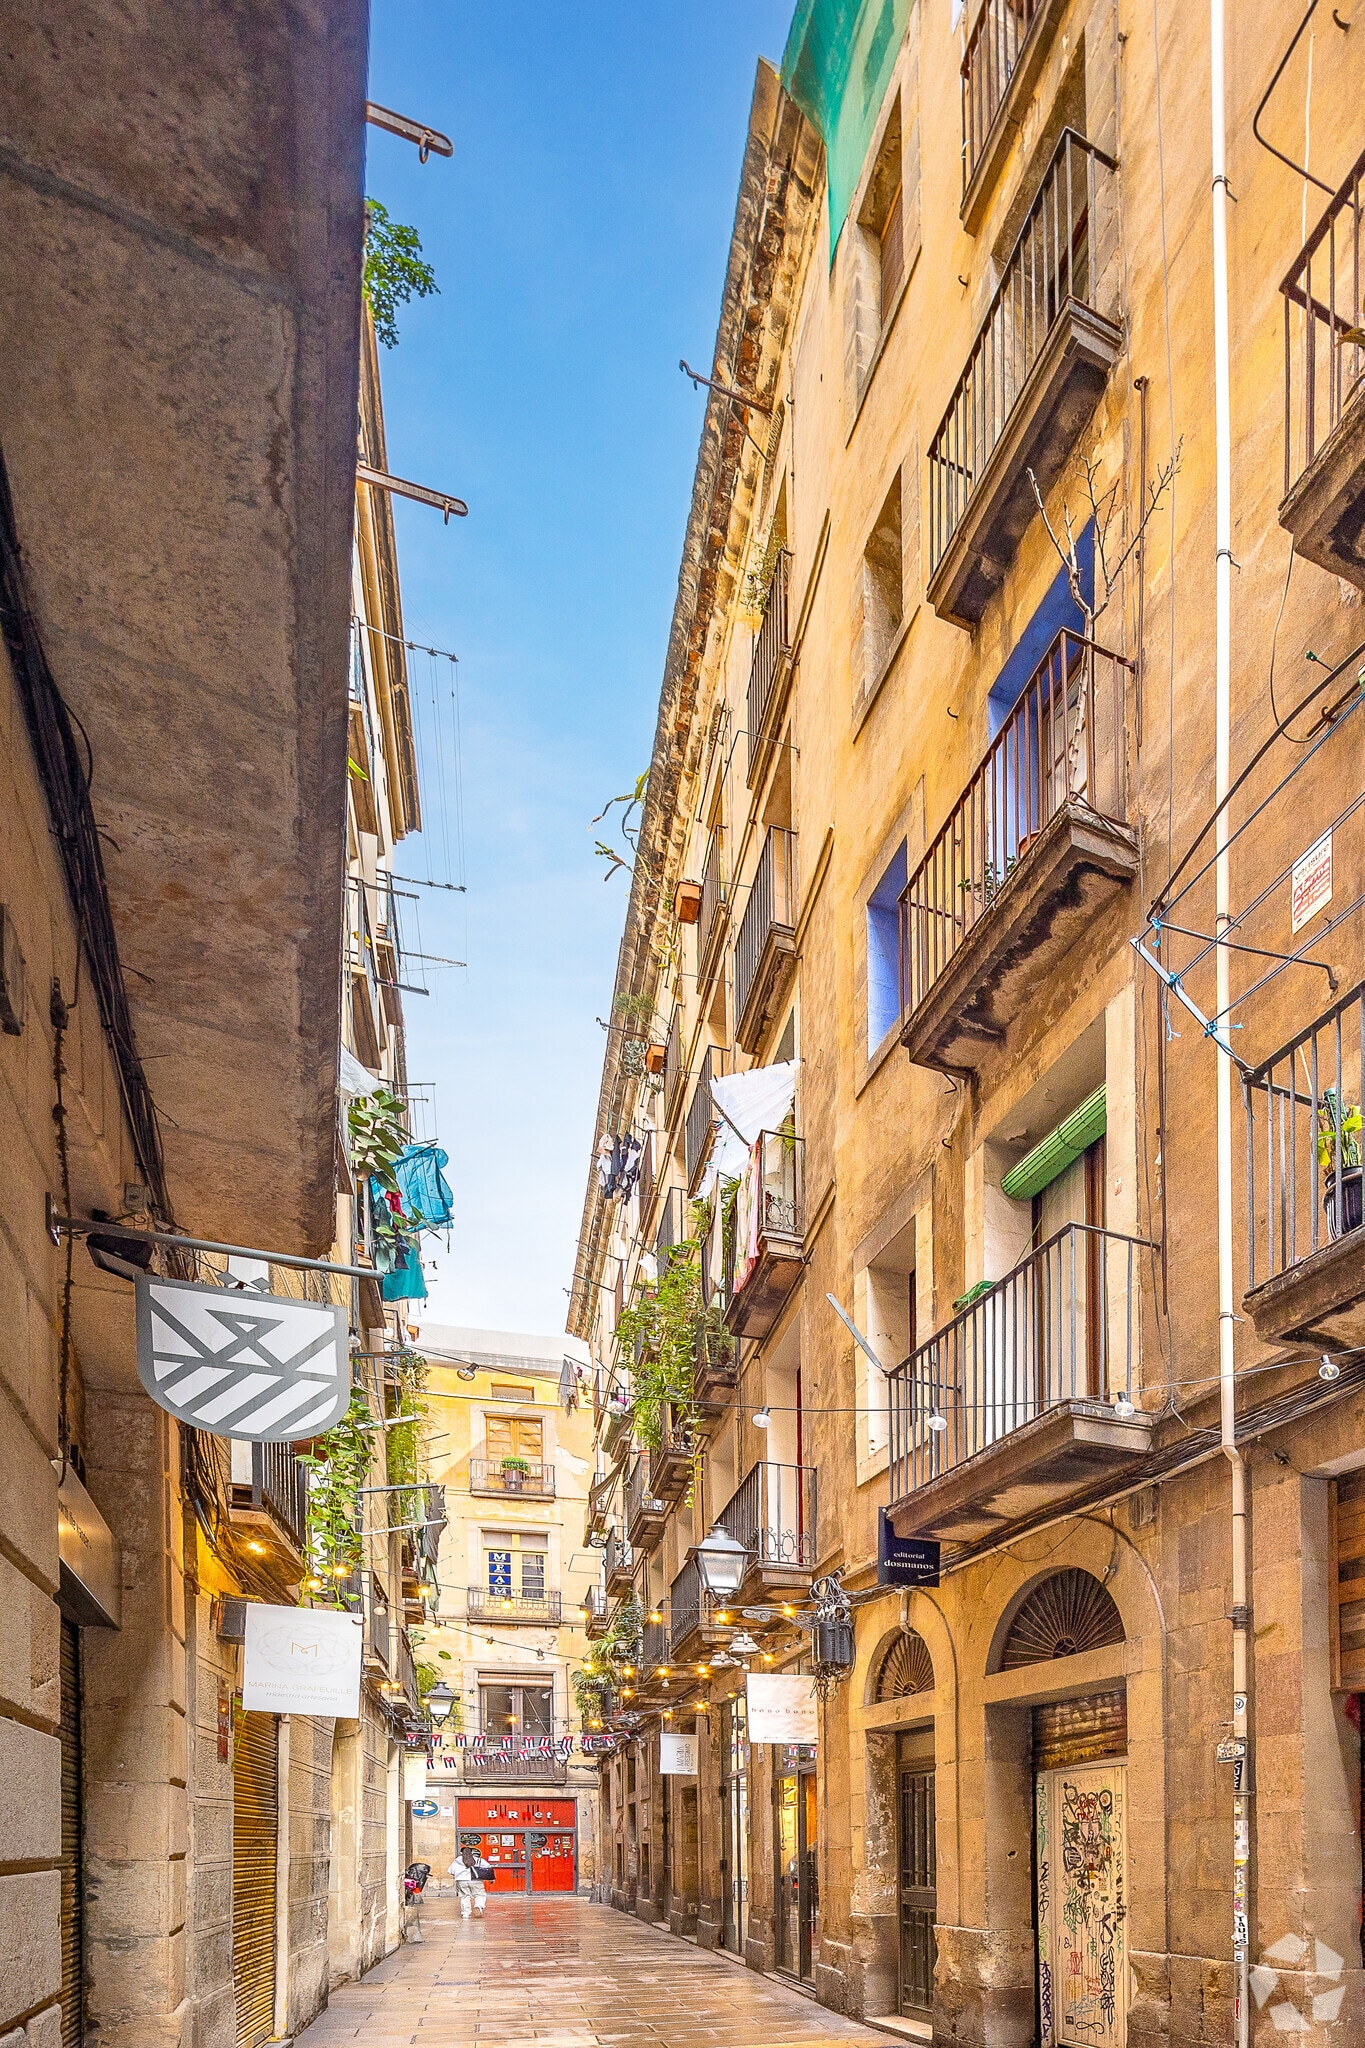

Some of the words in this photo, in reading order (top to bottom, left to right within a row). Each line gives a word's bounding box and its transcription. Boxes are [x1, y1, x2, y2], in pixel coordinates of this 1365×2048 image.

[893, 1551, 925, 1560] editorial
[883, 1559, 935, 1570] dosmanos
[493, 1553, 507, 1596] MEAM
[248, 1681, 289, 1690] MARINA
[291, 1685, 353, 1695] GRAFEUILLE
[265, 1691, 300, 1699] maestra
[301, 1694, 338, 1702] artesana
